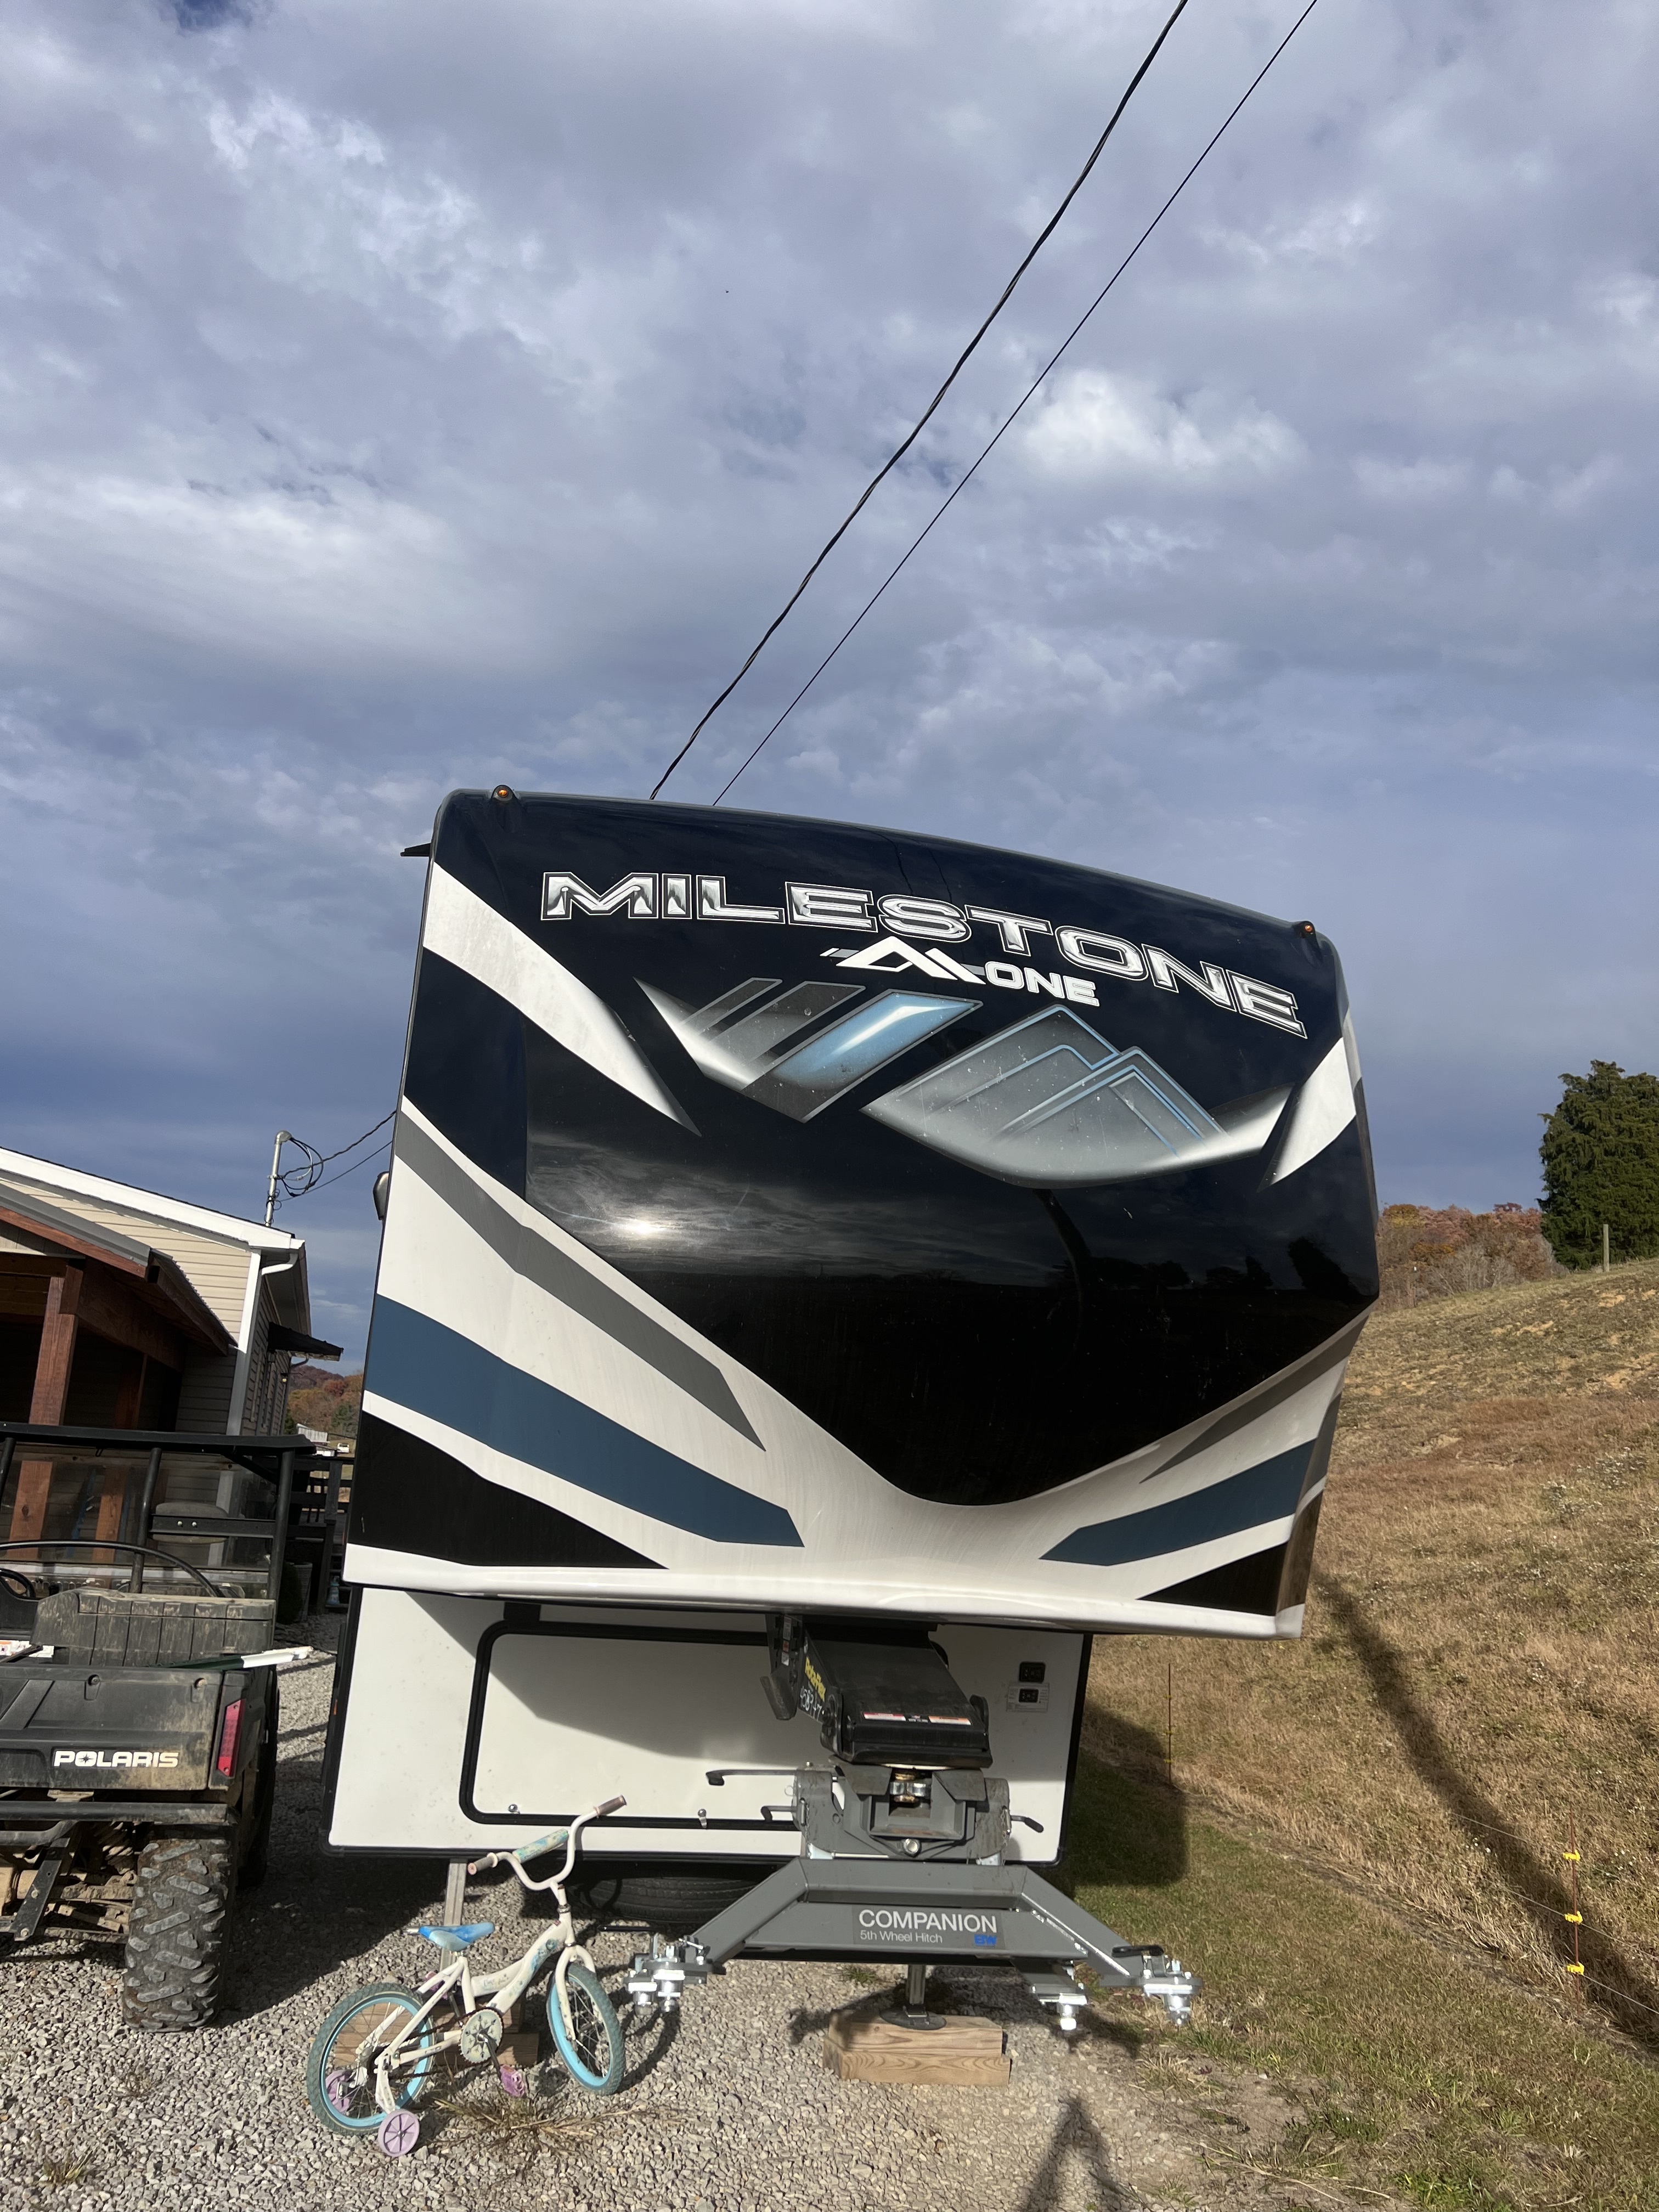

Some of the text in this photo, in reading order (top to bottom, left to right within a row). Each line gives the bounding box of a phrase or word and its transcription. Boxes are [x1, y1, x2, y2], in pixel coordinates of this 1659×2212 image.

[540, 871, 1308, 1039] MILESTONE
[985, 961, 1100, 1007] ONE
[54, 1750, 179, 1768] POLARIS
[859, 1909, 997, 1933] COMPANION
[860, 1929, 943, 1944] 5th Wheel Hitch
